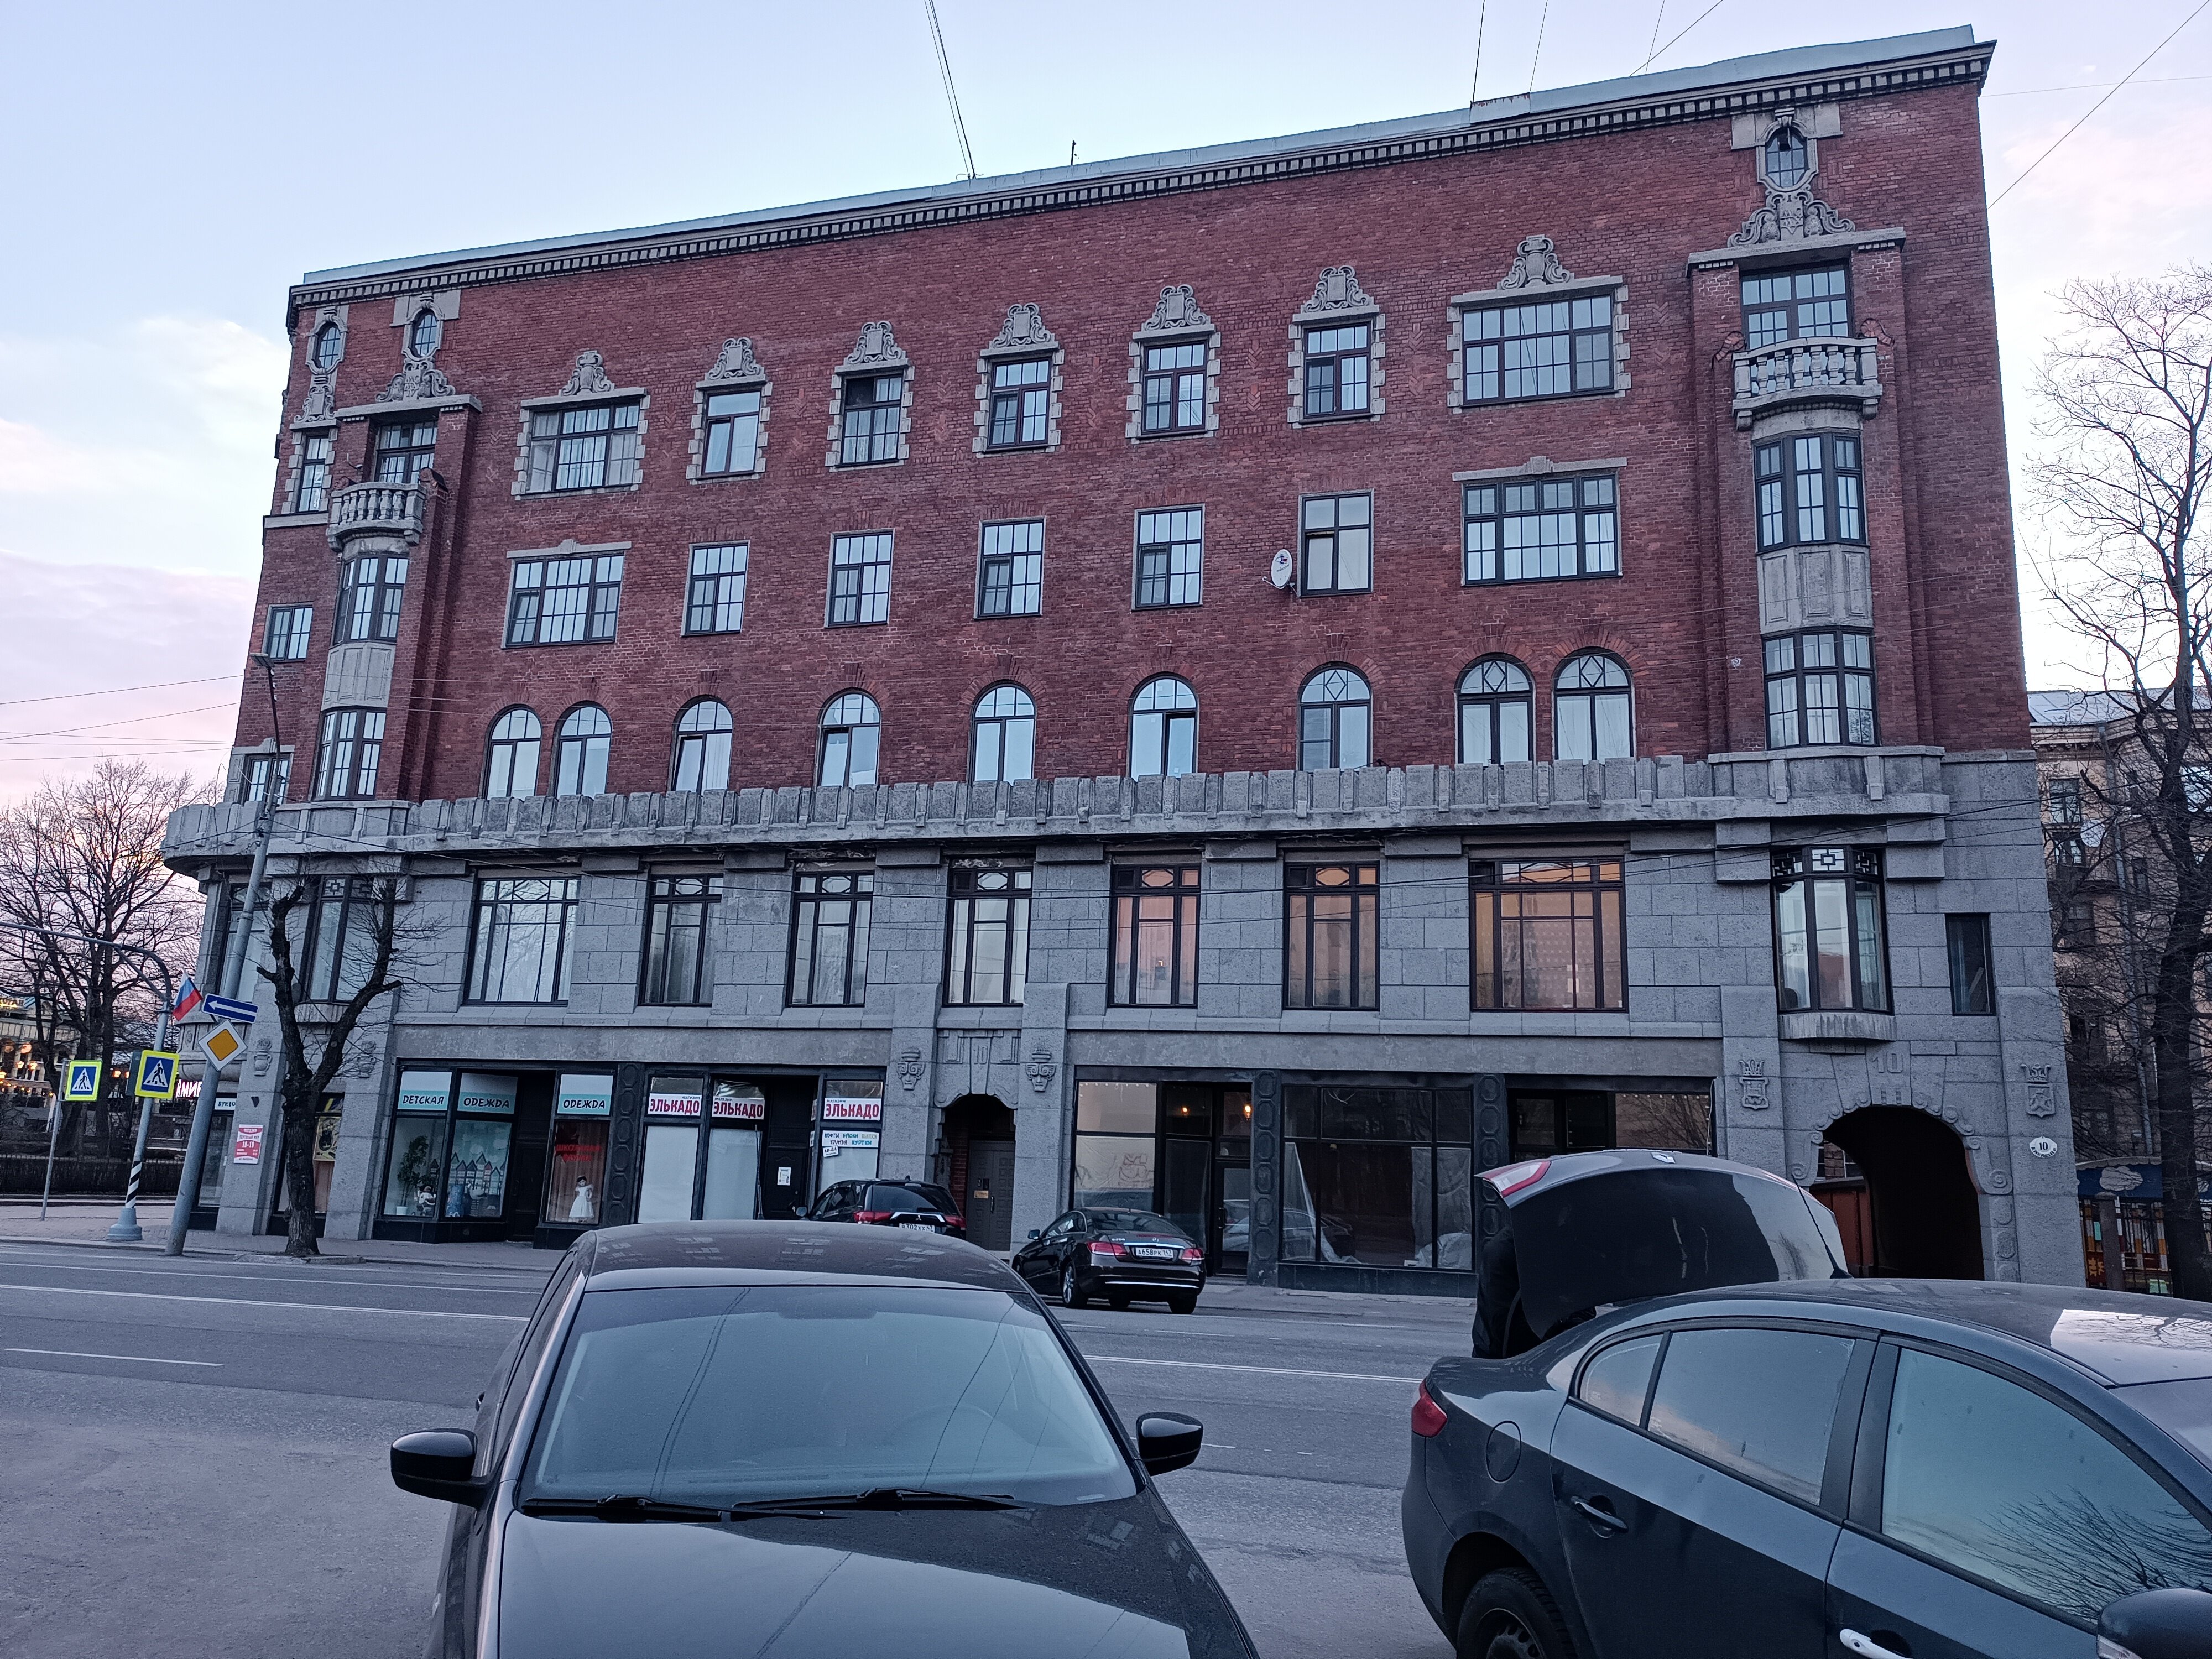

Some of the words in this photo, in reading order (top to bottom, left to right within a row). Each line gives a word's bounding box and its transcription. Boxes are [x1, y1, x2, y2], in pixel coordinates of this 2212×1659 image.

[403, 1095, 444, 1105] ДЕТСКАЯ
[463, 1097, 509, 1108] ОДЕЖДА
[563, 1099, 605, 1109] ОДЕЖДА
[650, 1099, 700, 1115] ЭЛЬКАДО
[713, 1102, 763, 1118] ЭЛЬКАДО
[825, 1103, 879, 1119] ЭЛЬКАДО
[2039, 1142, 2048, 1150] 10
